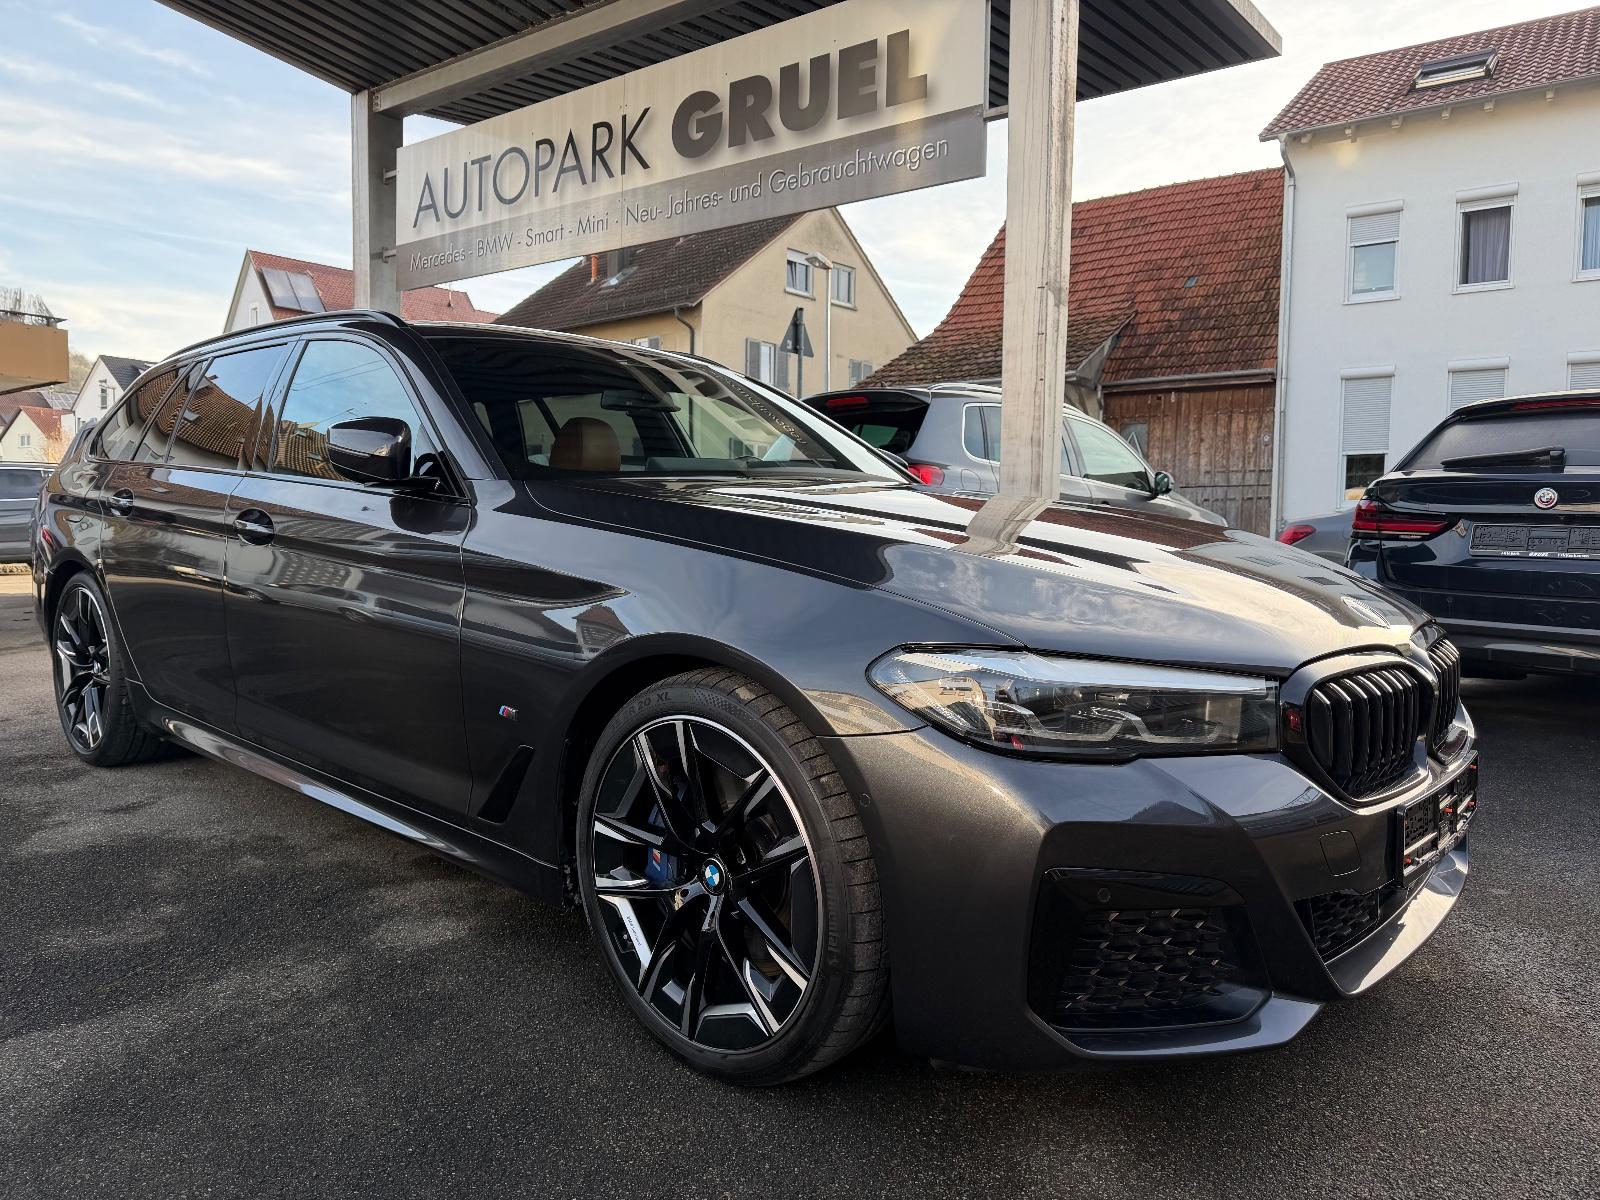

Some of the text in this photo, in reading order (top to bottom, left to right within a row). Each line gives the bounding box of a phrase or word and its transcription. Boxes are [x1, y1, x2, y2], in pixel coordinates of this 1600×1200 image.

[413, 28, 927, 228] AUTOPARK GRUEL
[410, 241, 466, 272] Mercedes
[477, 231, 513, 258] BMW
[525, 223, 564, 247] Smart
[576, 211, 609, 237] Mini
[729, 171, 762, 204] und
[768, 139, 949, 193] Gebrauchtwagen
[656, 691, 672, 702] XL
